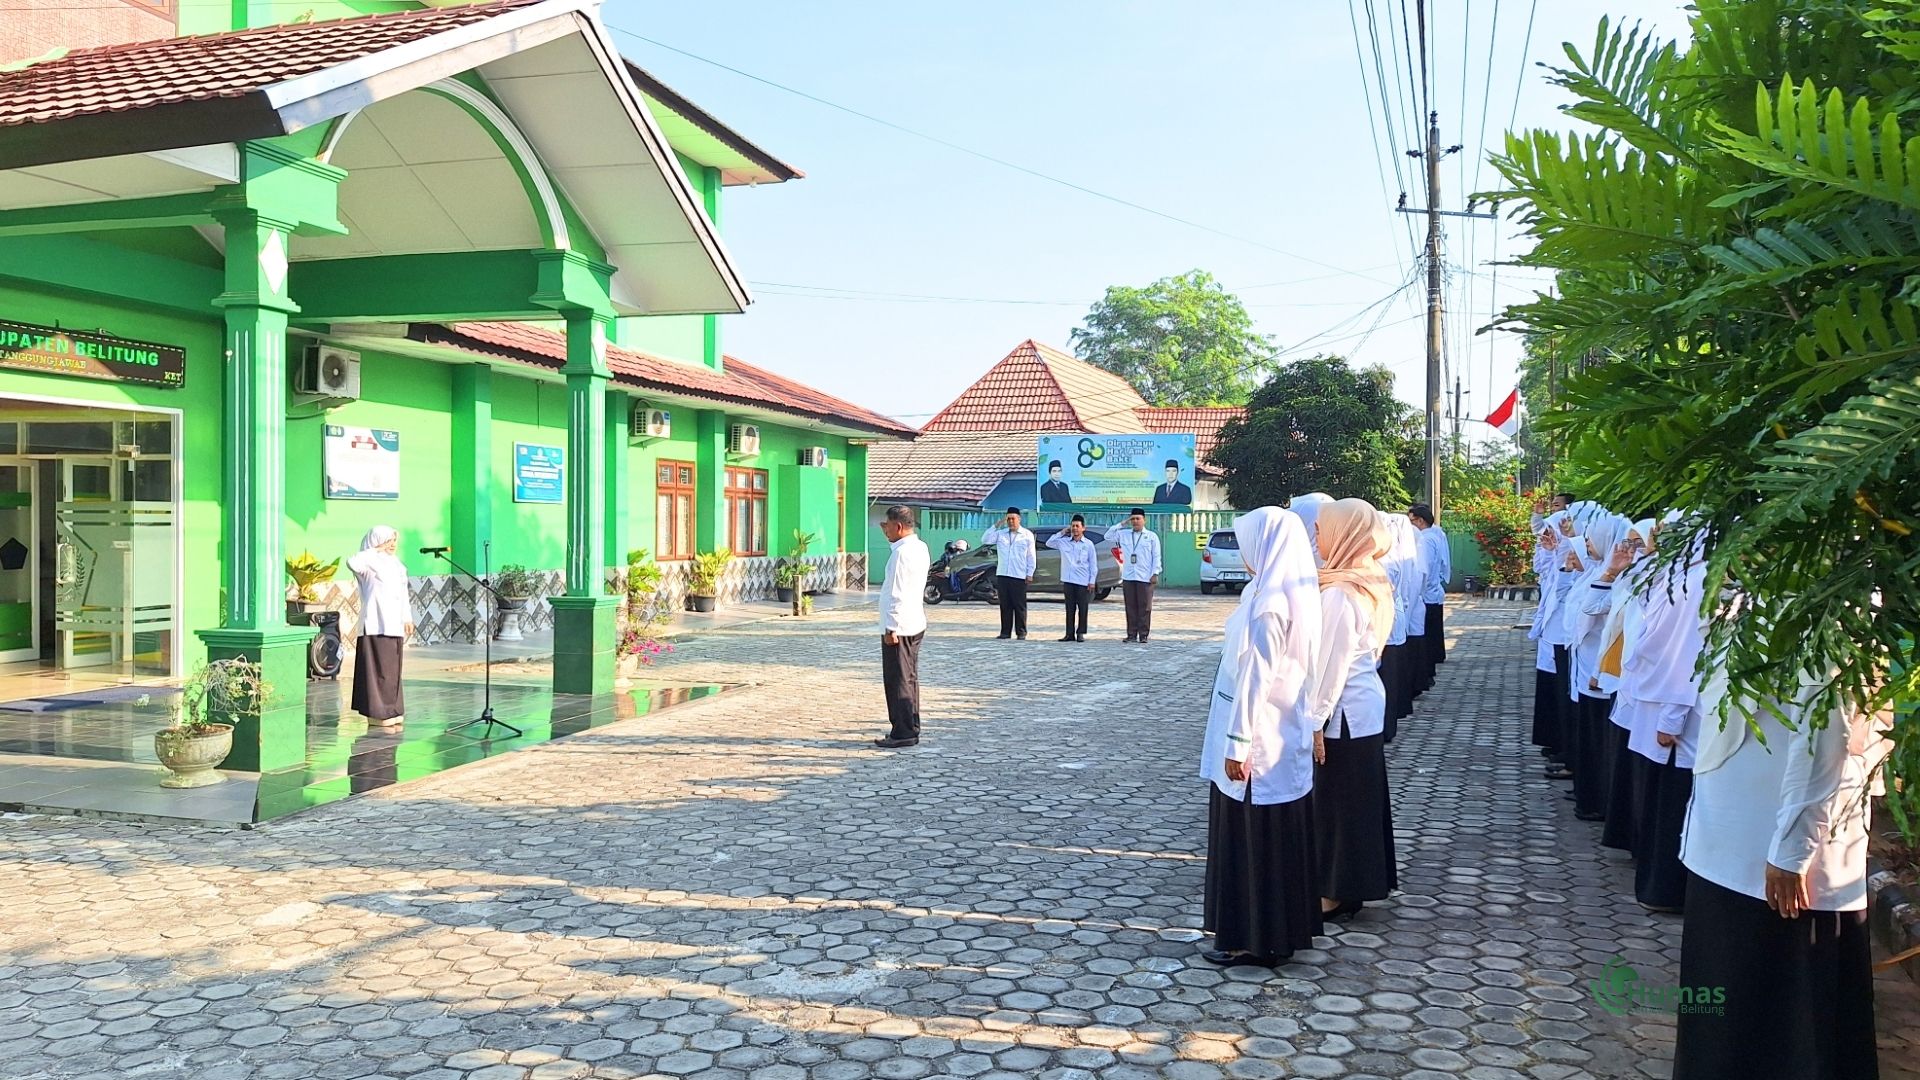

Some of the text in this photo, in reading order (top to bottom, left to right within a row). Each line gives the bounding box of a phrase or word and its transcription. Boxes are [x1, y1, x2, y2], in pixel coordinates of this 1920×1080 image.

[75, 341, 159, 367] BELITUNG
[1106, 439, 1154, 448] Dirgahayu
[1106, 455, 1132, 463] Bakti
